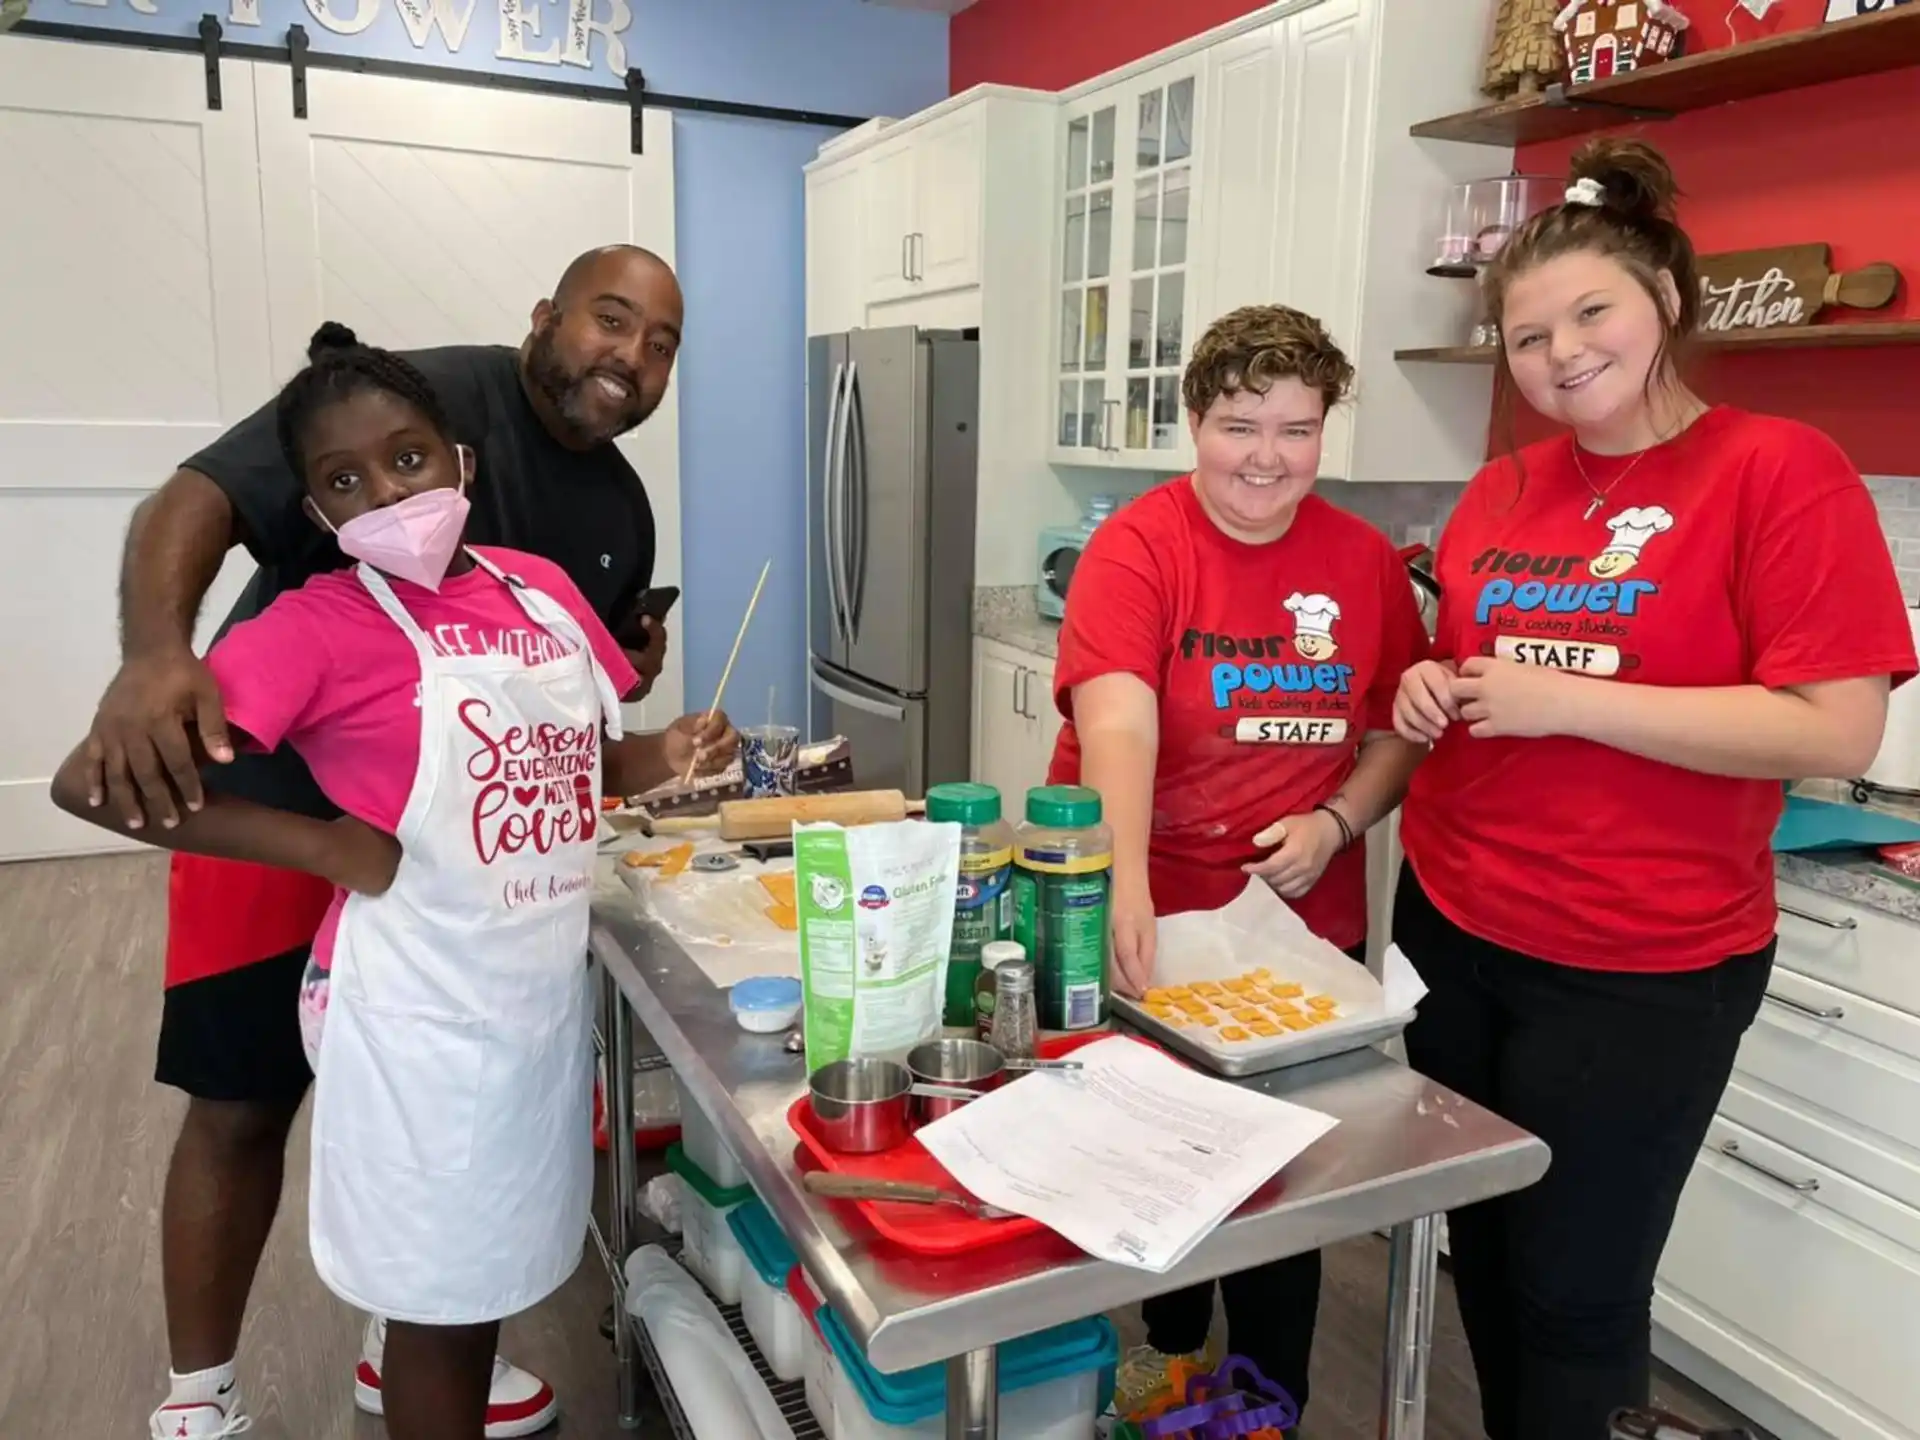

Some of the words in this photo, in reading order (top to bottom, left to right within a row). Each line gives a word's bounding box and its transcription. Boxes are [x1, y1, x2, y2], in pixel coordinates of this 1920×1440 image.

[1471, 548, 1585, 578] flour
[1475, 578, 1659, 625] power
[1525, 618, 1572, 635] cooking
[477, 627, 573, 666] WITHO
[1181, 628, 1286, 659] flour
[1515, 643, 1595, 669] STAFF
[1212, 662, 1355, 709] power
[1258, 722, 1333, 741] STAFF
